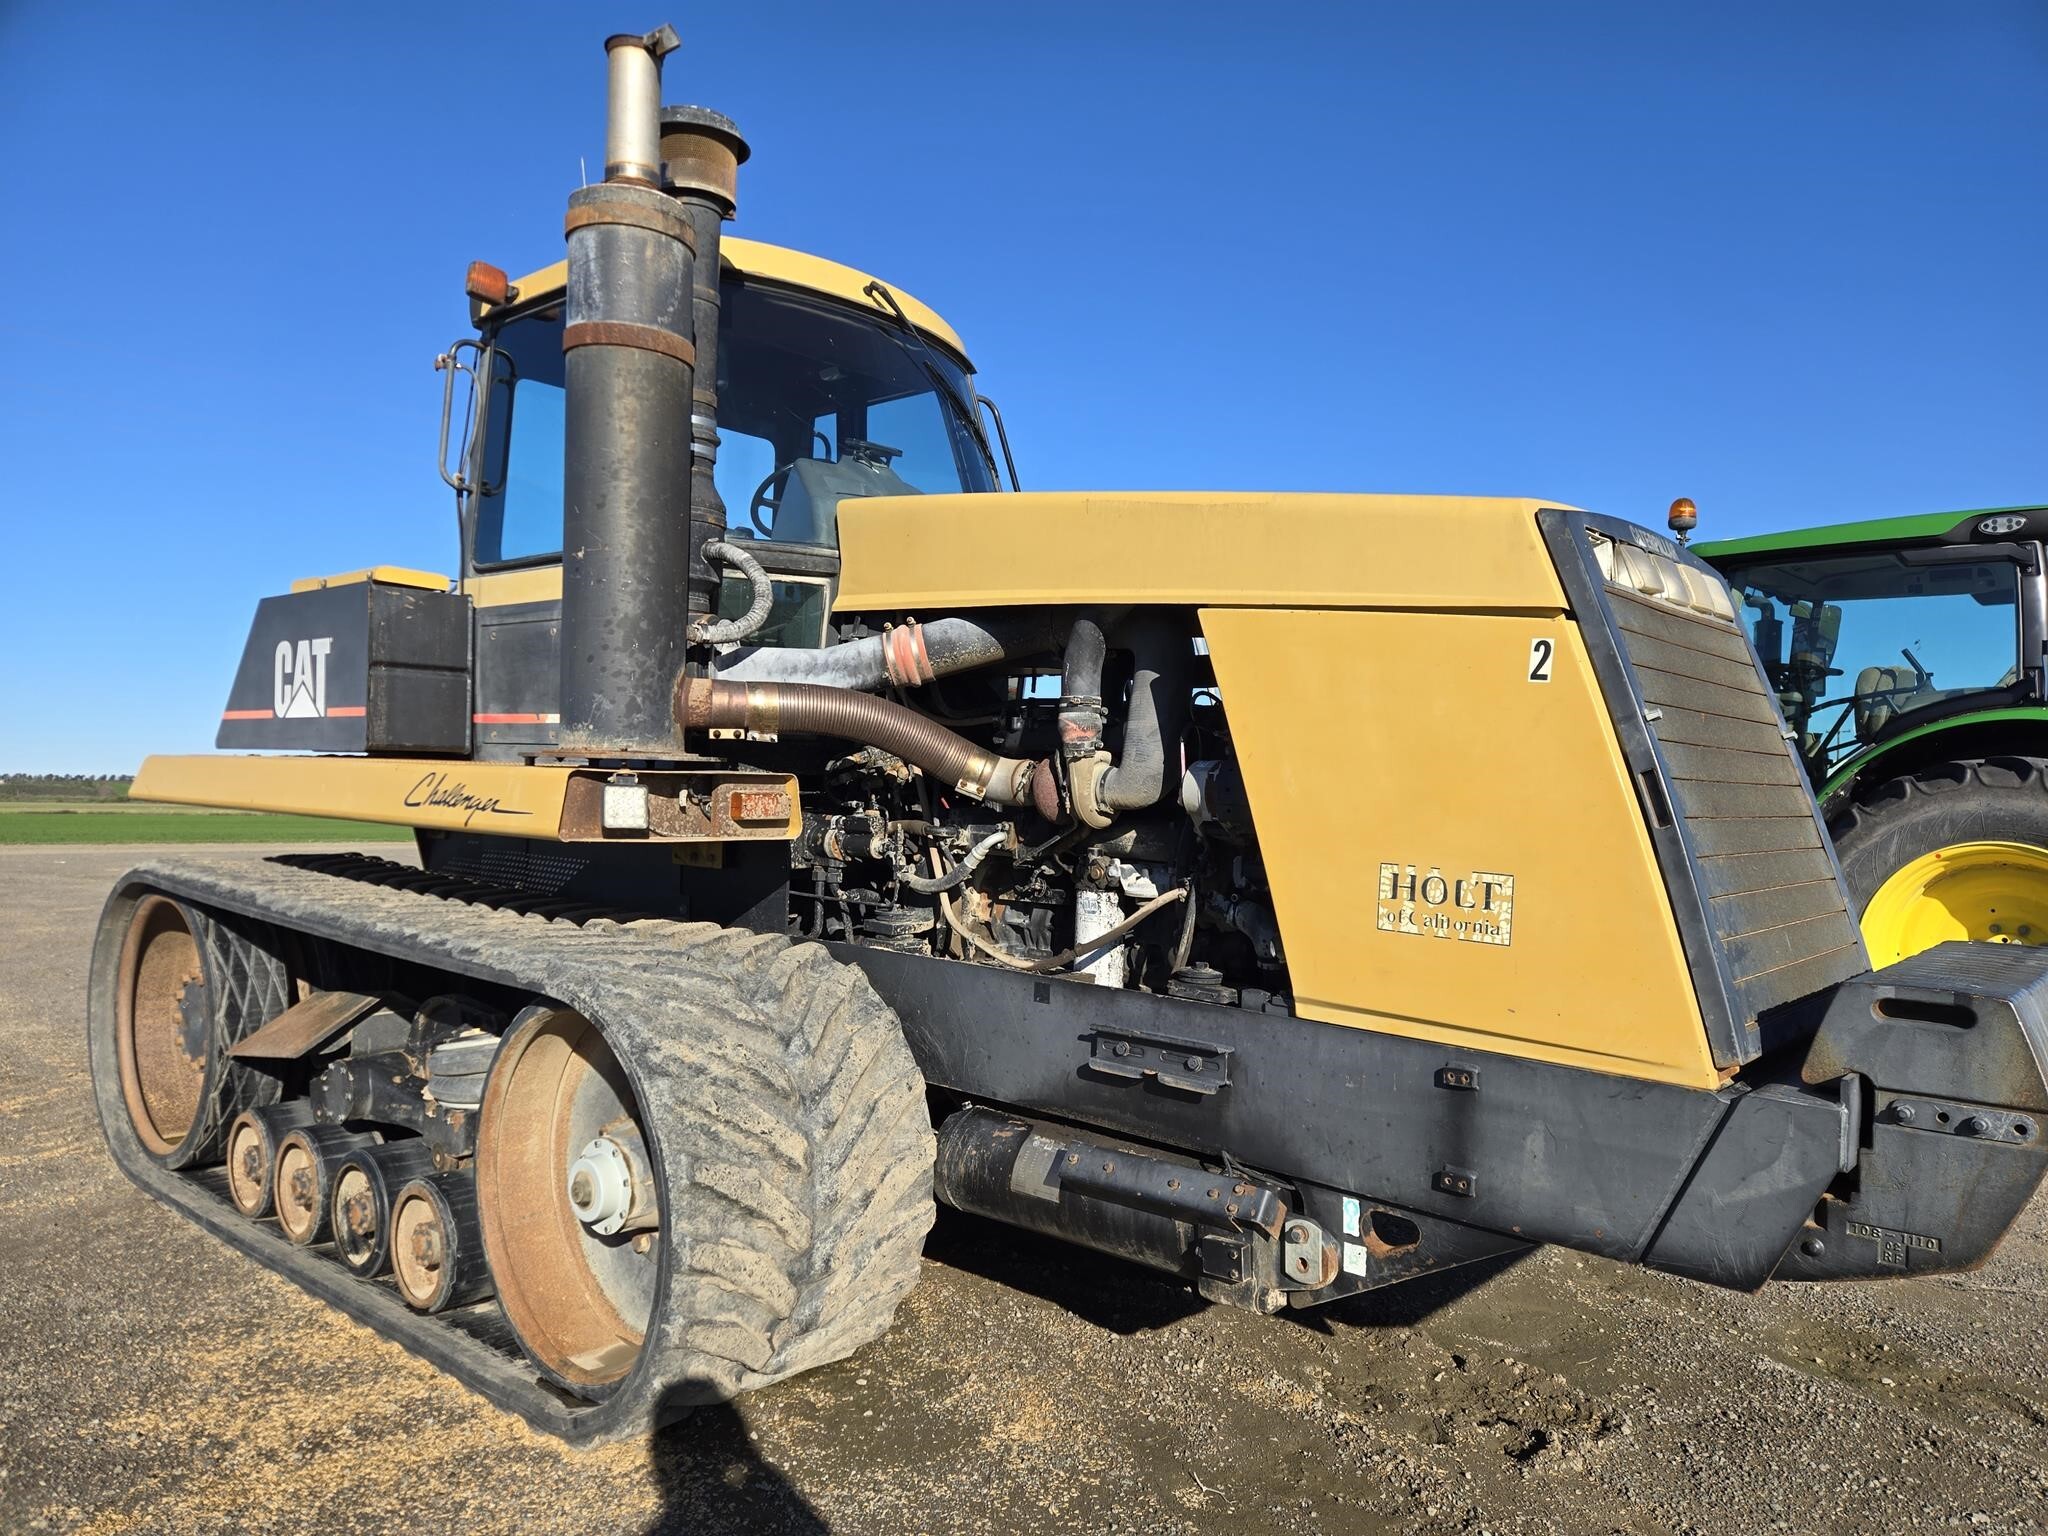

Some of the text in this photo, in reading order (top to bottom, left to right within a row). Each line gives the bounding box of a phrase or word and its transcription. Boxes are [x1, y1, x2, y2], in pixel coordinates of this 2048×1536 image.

[274, 637, 333, 719] CAT
[1529, 639, 1552, 681] 2
[404, 772, 534, 827] Challenger
[1389, 872, 1503, 911] HOLT
